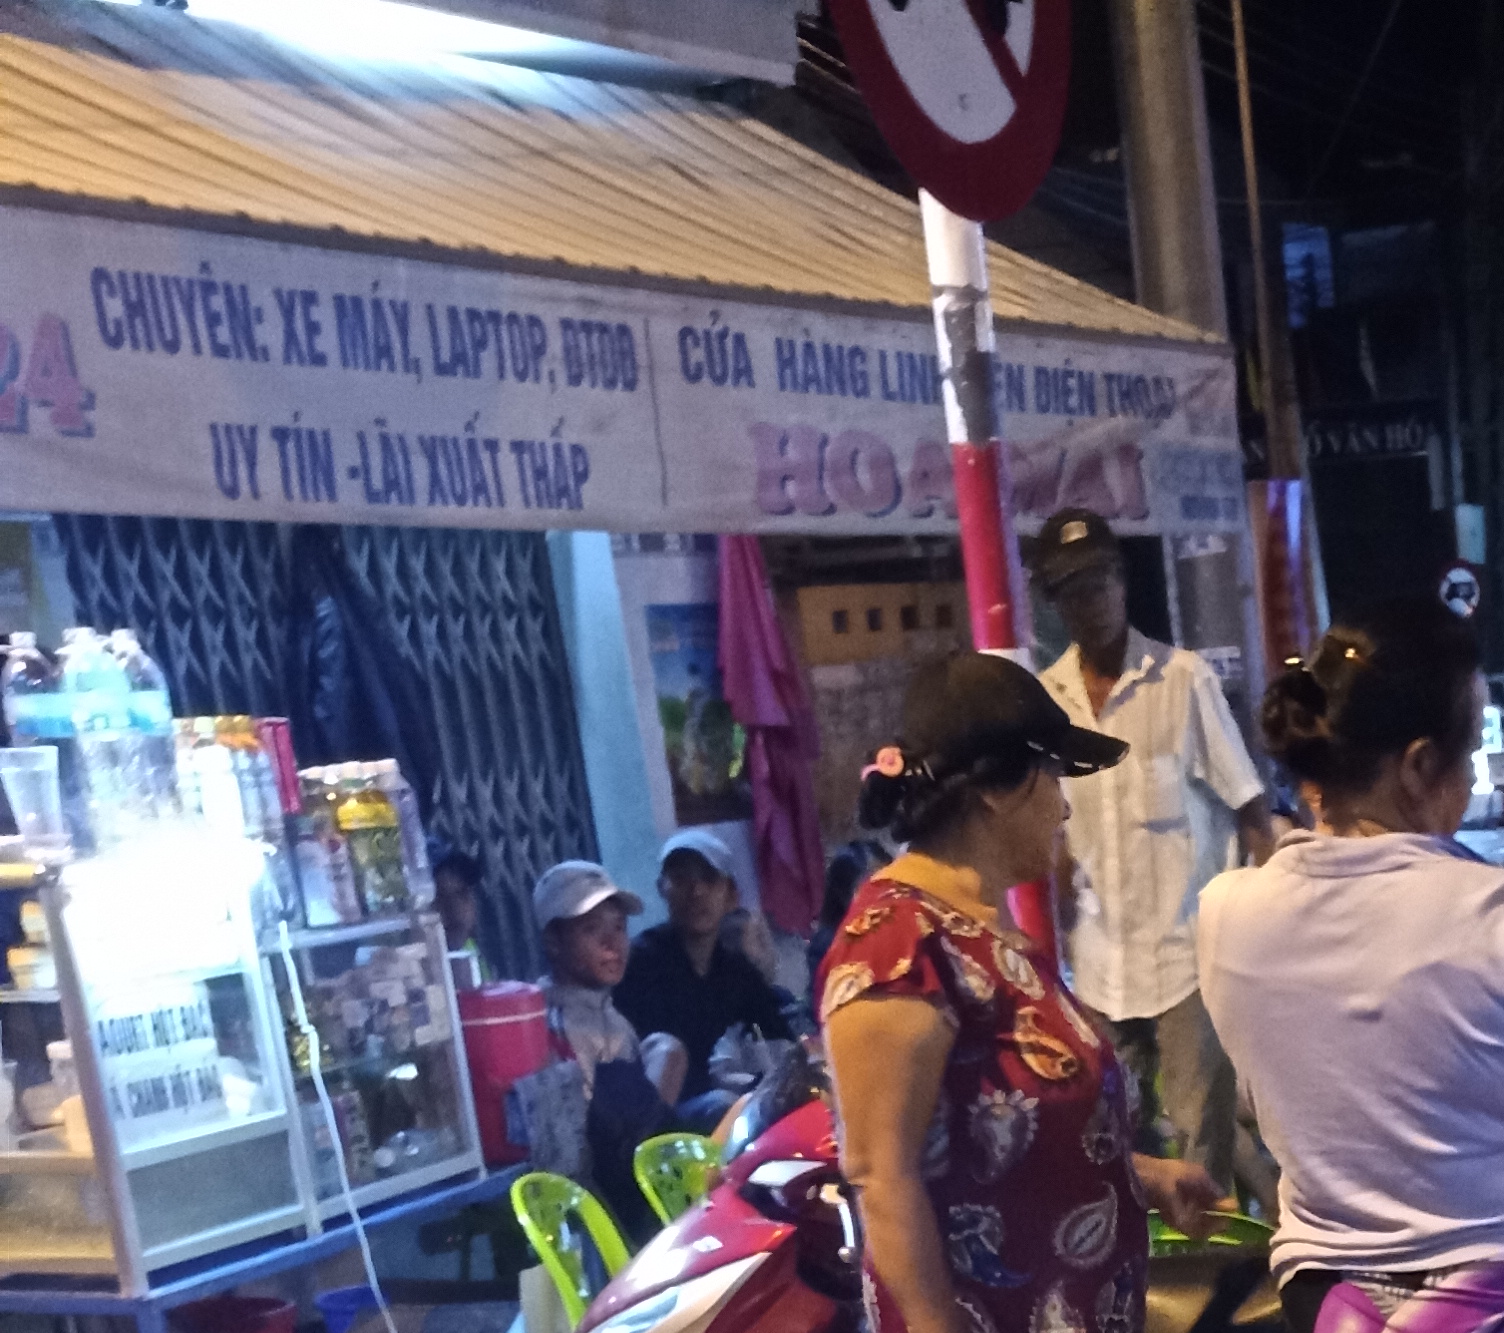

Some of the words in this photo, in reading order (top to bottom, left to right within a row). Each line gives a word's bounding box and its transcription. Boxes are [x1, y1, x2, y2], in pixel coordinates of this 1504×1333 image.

[90, 260, 270, 362] CHUYÊN:
[272, 286, 328, 367] XE
[332, 279, 422, 384] MÁY,
[425, 303, 556, 394] LAPTOP,
[678, 308, 756, 389] CỬA
[774, 326, 871, 399] HÀNG
[209, 420, 261, 501] UY
[269, 410, 338, 504] TÍN
[417, 410, 505, 508] XUẤT
[509, 415, 590, 511] THẤP
